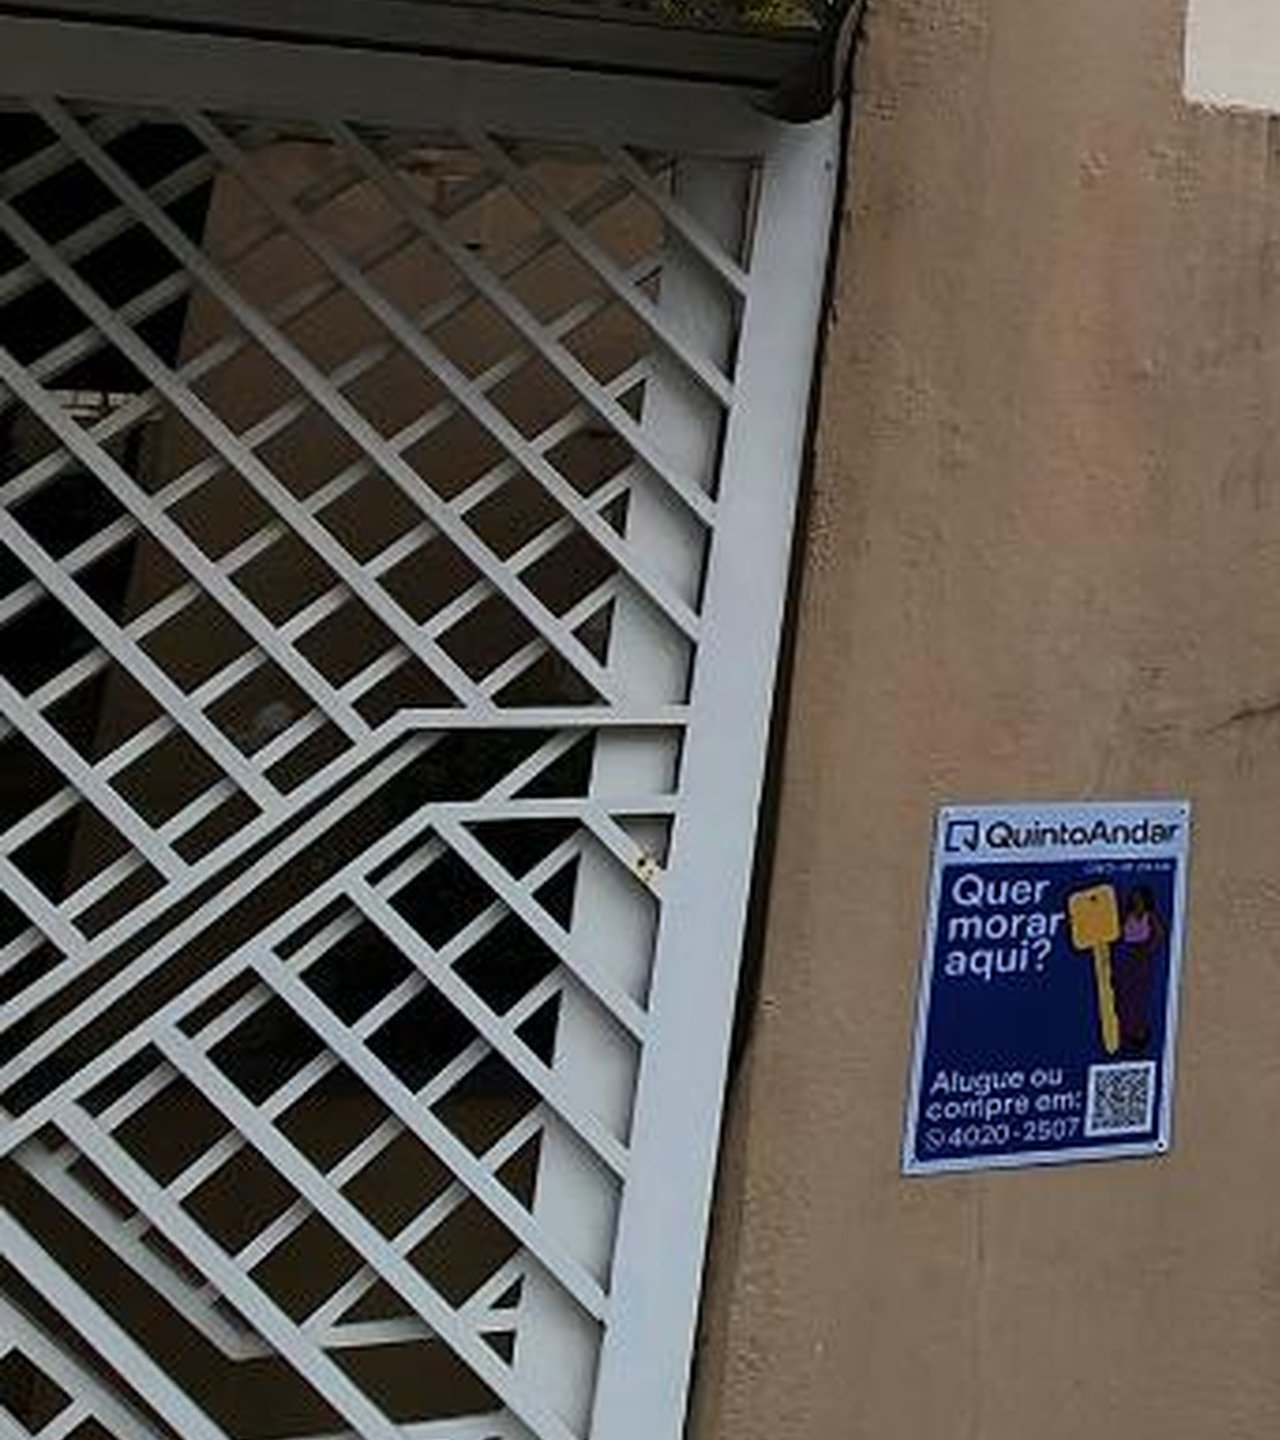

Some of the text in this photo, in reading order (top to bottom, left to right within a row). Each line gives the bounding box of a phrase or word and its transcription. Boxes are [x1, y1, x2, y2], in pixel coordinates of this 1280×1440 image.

[985, 819, 1179, 848] QuintoAndar
[951, 873, 1051, 906] Quer
[947, 910, 1066, 941] morar
[944, 938, 1053, 980] aqui?
[929, 1068, 1063, 1097] Alugue ou
[925, 1090, 1083, 1122] compre em:
